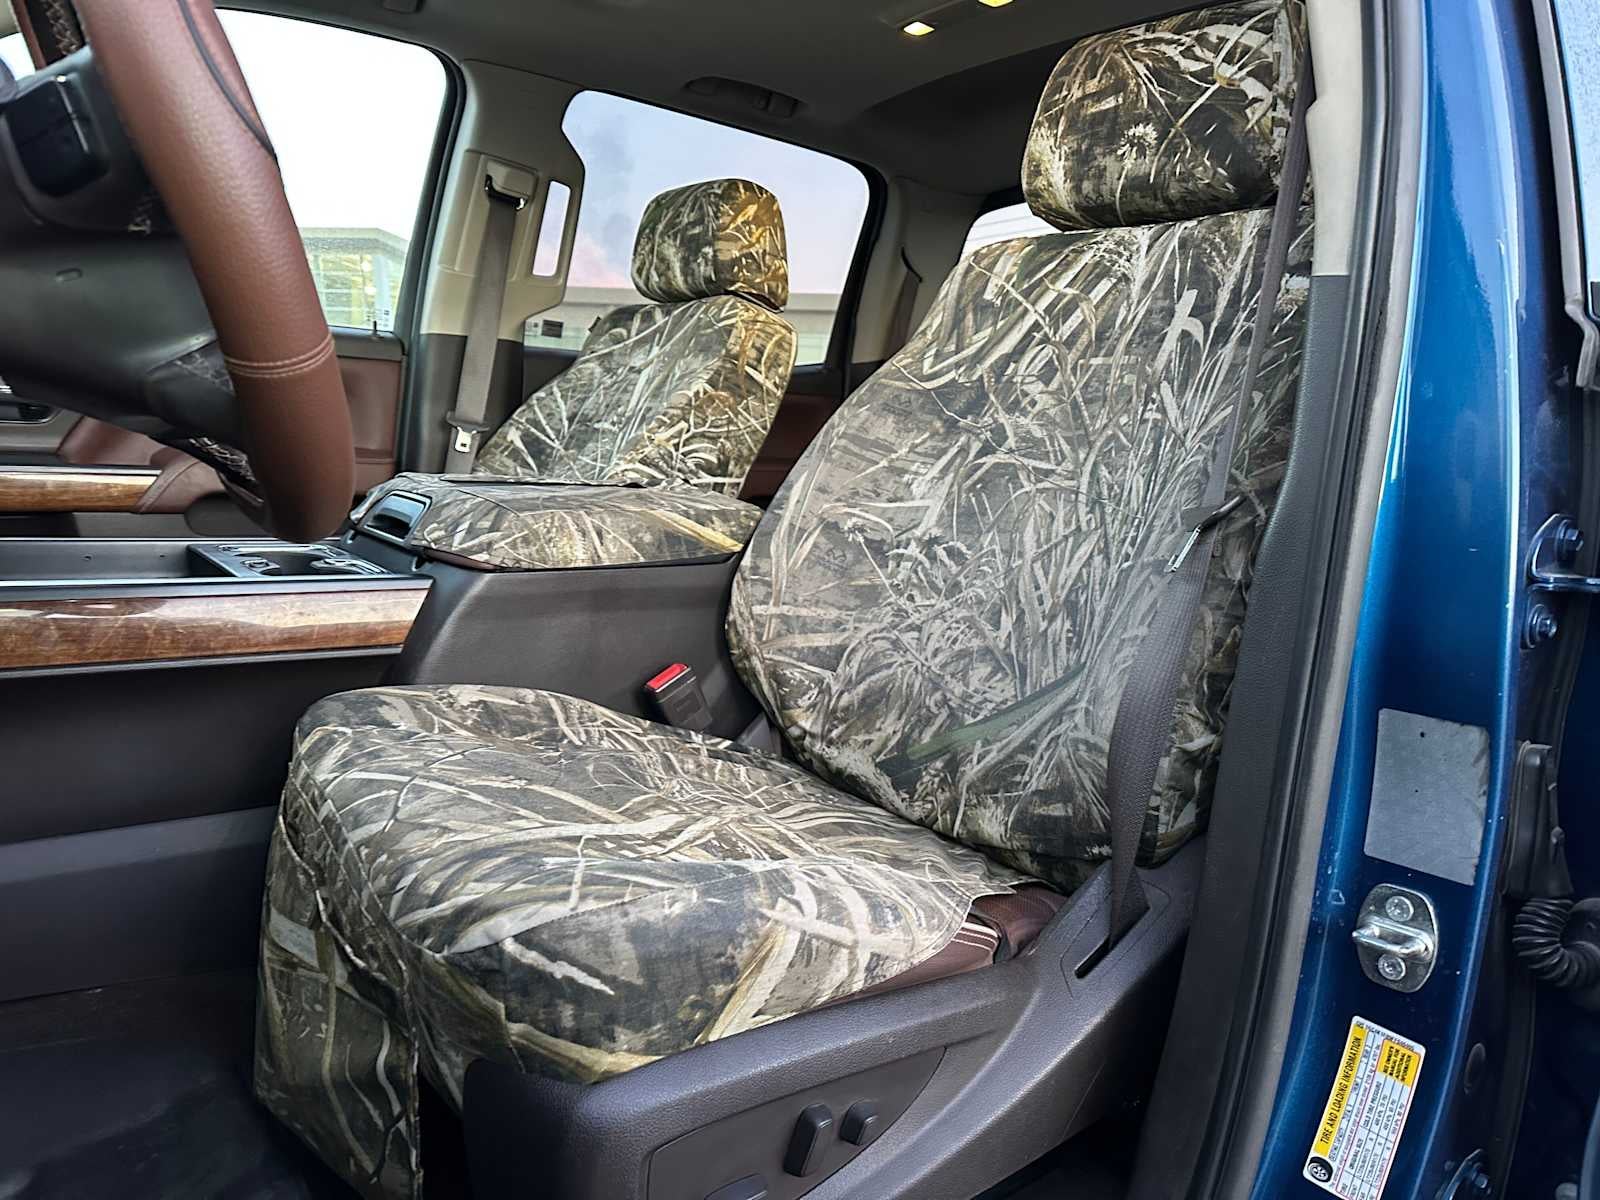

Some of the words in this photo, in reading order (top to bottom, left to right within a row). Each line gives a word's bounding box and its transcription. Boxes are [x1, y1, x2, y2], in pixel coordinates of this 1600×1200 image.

[1320, 1128, 1332, 1144] TIRE
[1327, 1111, 1337, 1127] AND
[1333, 1081, 1347, 1112] LOADING
[1342, 1036, 1362, 1082] INFORMATION
